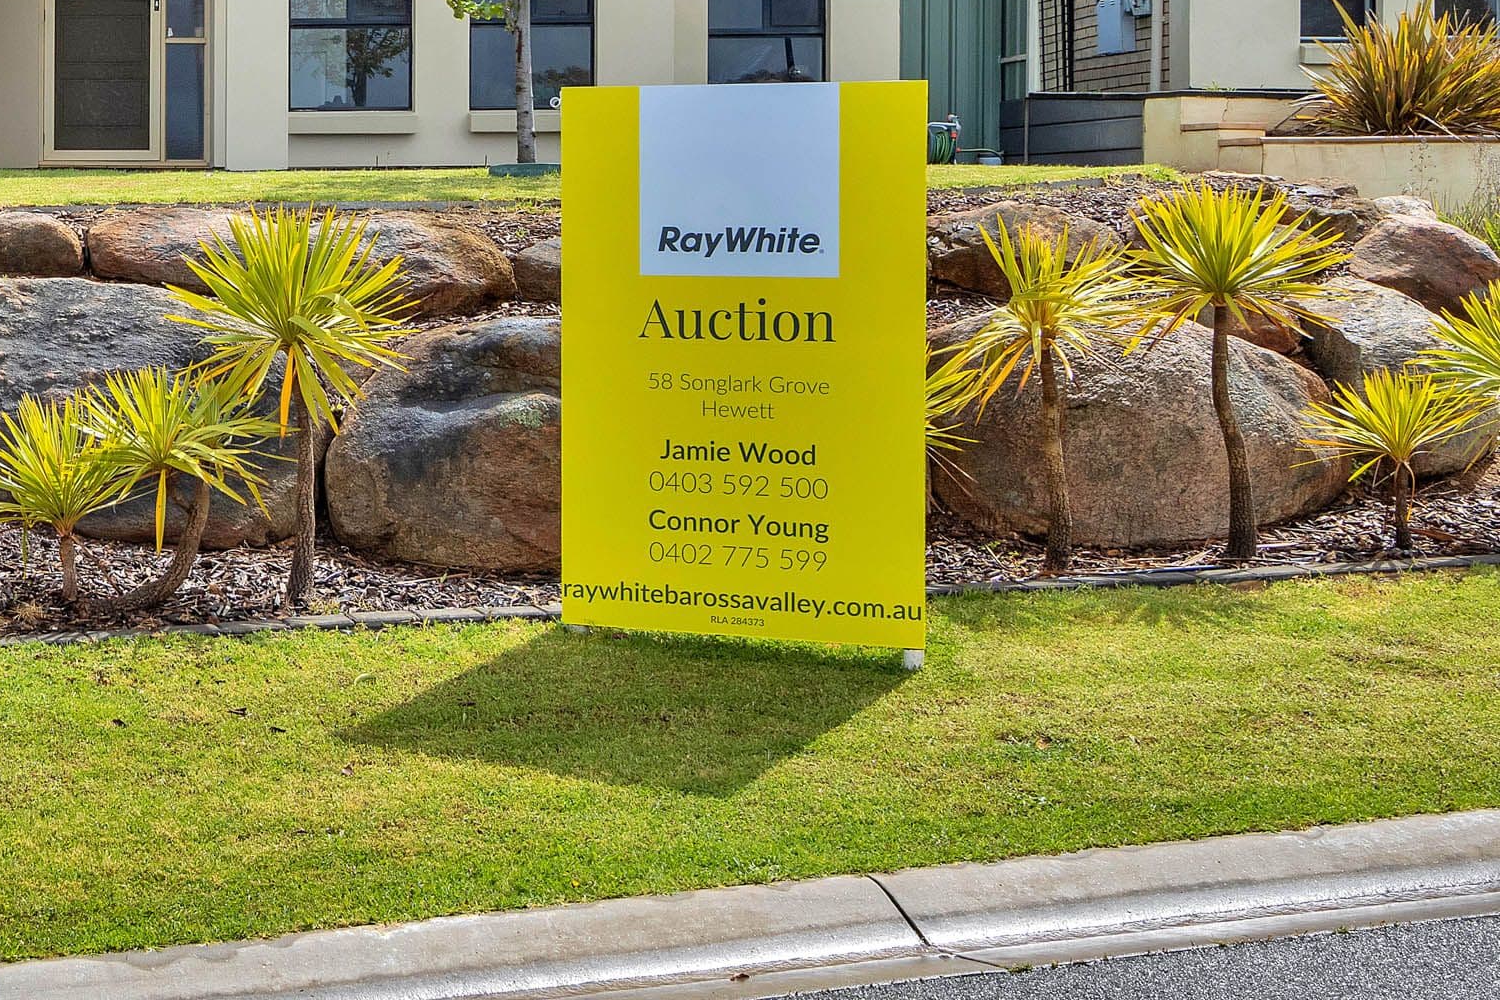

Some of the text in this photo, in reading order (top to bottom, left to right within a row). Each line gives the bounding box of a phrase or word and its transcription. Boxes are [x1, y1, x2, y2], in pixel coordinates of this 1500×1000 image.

[638, 297, 837, 343] Auction
[648, 372, 831, 396] 58 Songlark Grove
[701, 399, 776, 420] Hewett
[659, 438, 817, 467] Jamie Wood
[649, 470, 829, 500] 0403 592 500
[649, 509, 830, 544] Connor Young
[649, 541, 828, 572] 0402 775 599
[563, 580, 922, 622] raywhitebarossavalley.com.au
[710, 615, 765, 627] RLA 284373
